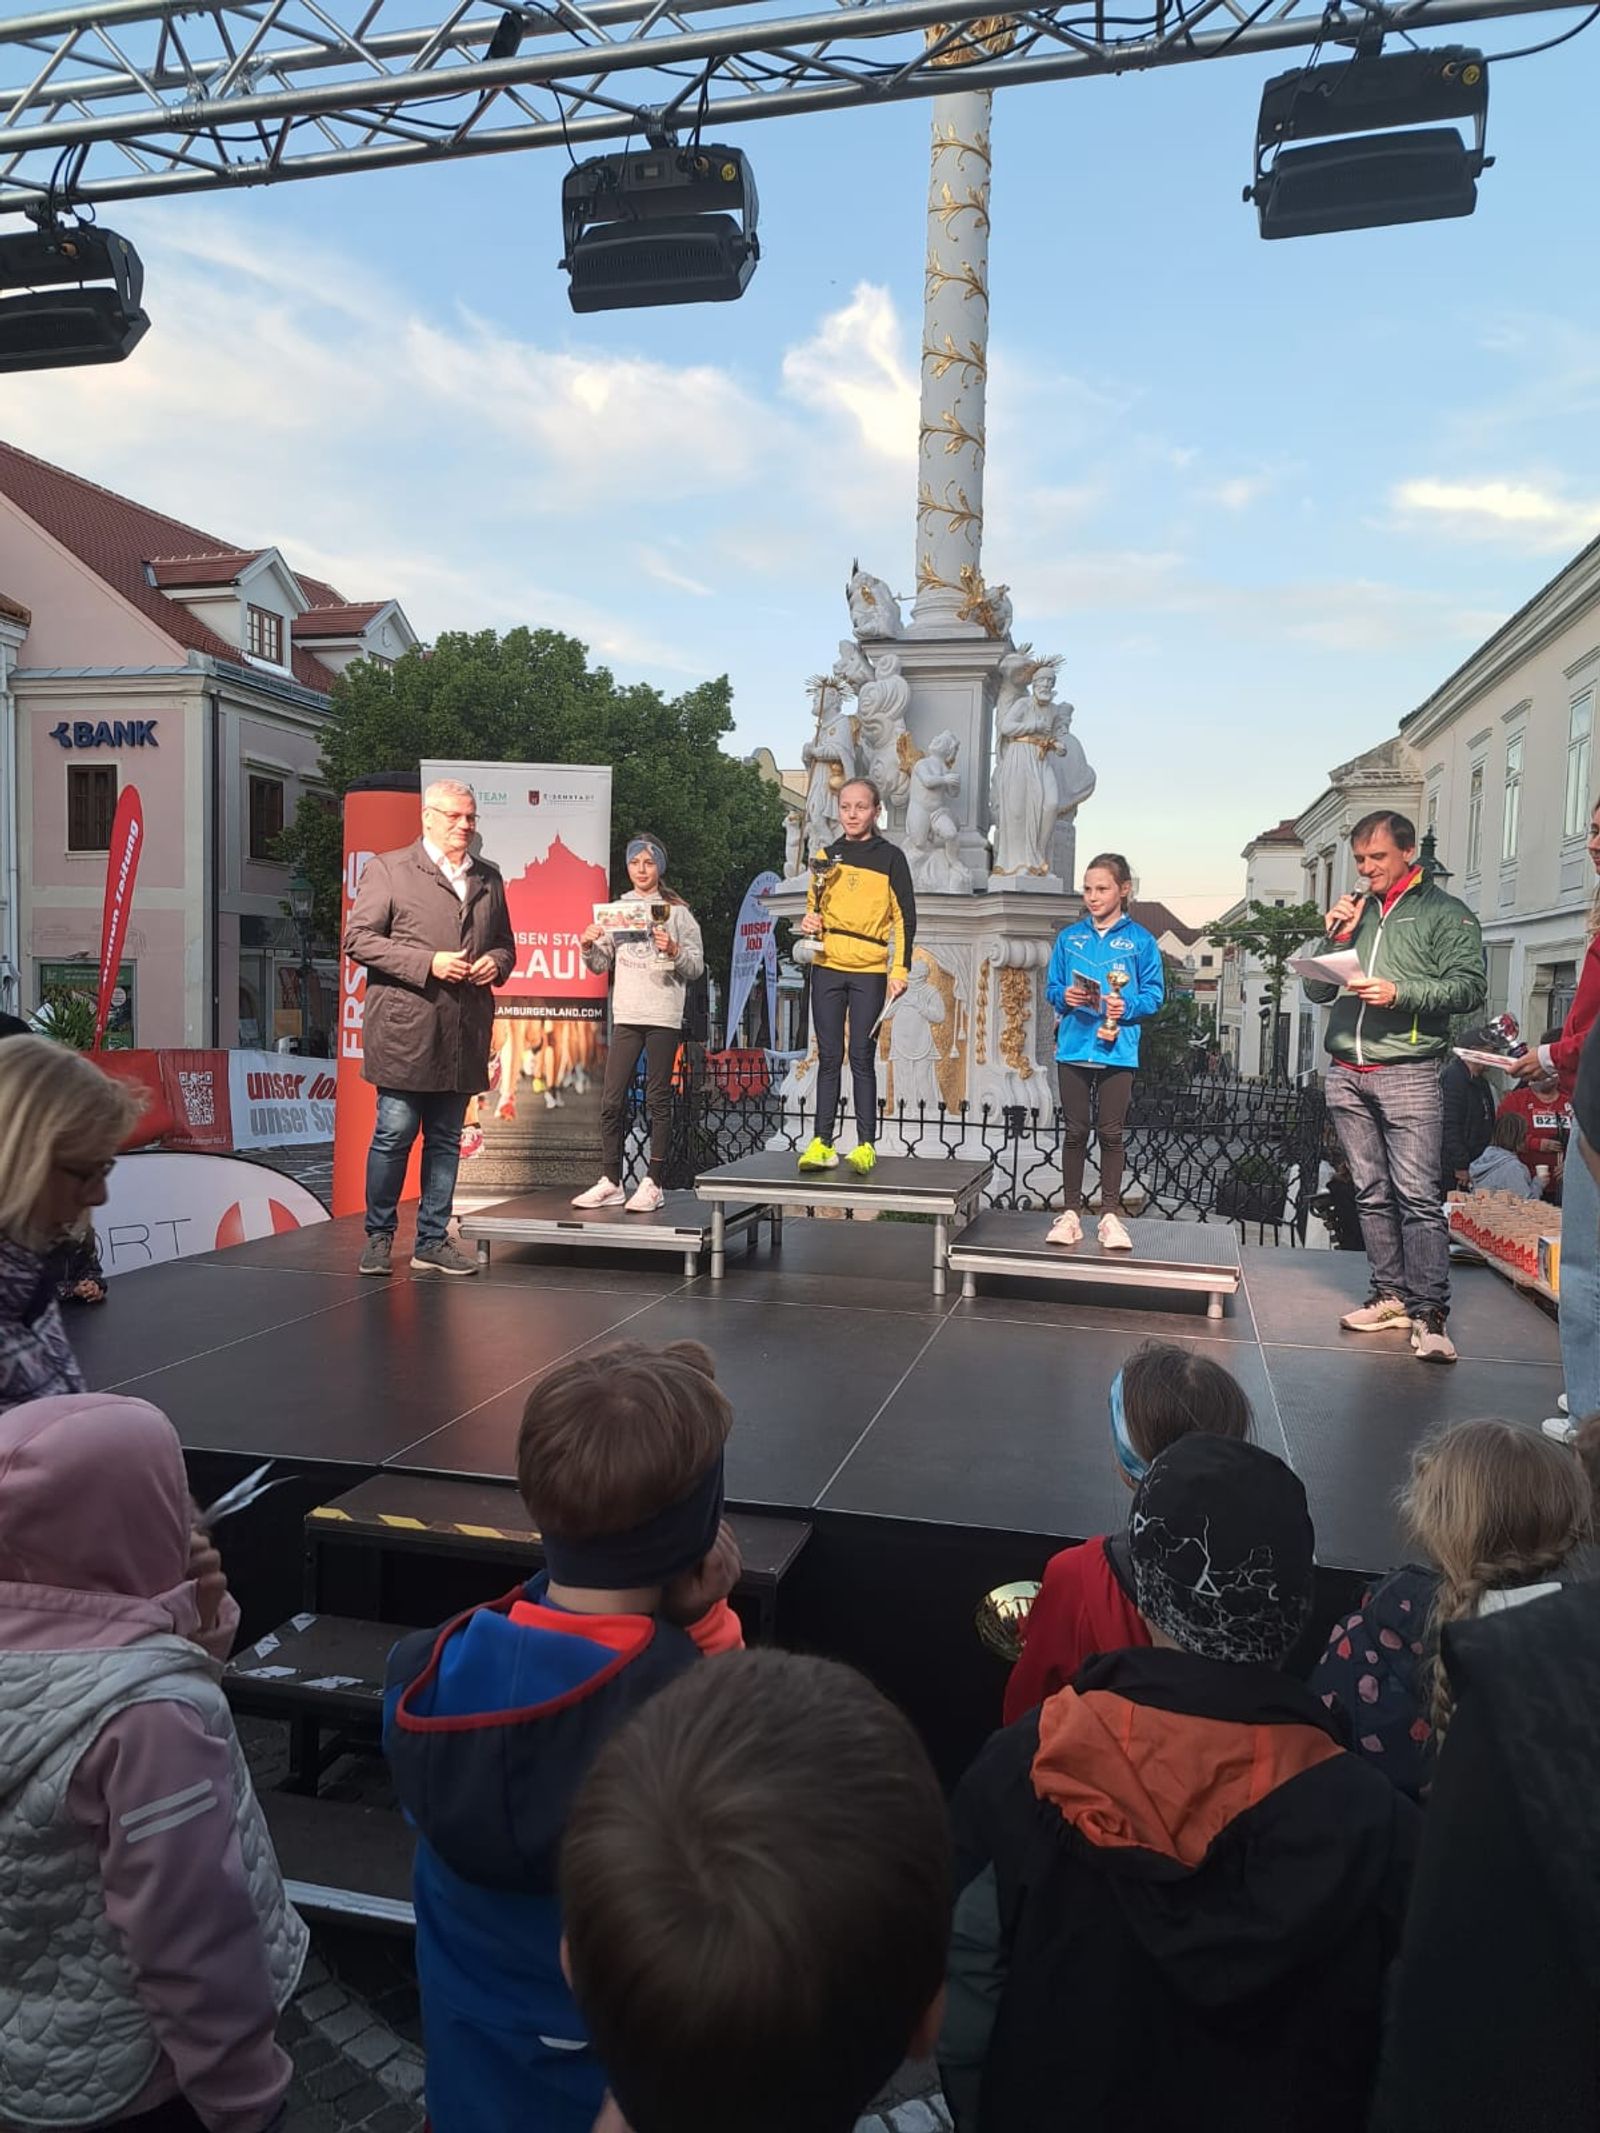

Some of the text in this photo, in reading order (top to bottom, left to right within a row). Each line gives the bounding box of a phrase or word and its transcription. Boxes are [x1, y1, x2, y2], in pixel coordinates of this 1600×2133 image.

[73, 720, 159, 748] BANK
[478, 791, 507, 801] TEAM
[740, 922, 772, 936] unser
[495, 1006, 602, 1018] AMBURGENLAND.COM
[246, 1072, 307, 1101] unser
[250, 1106, 309, 1136] unser
